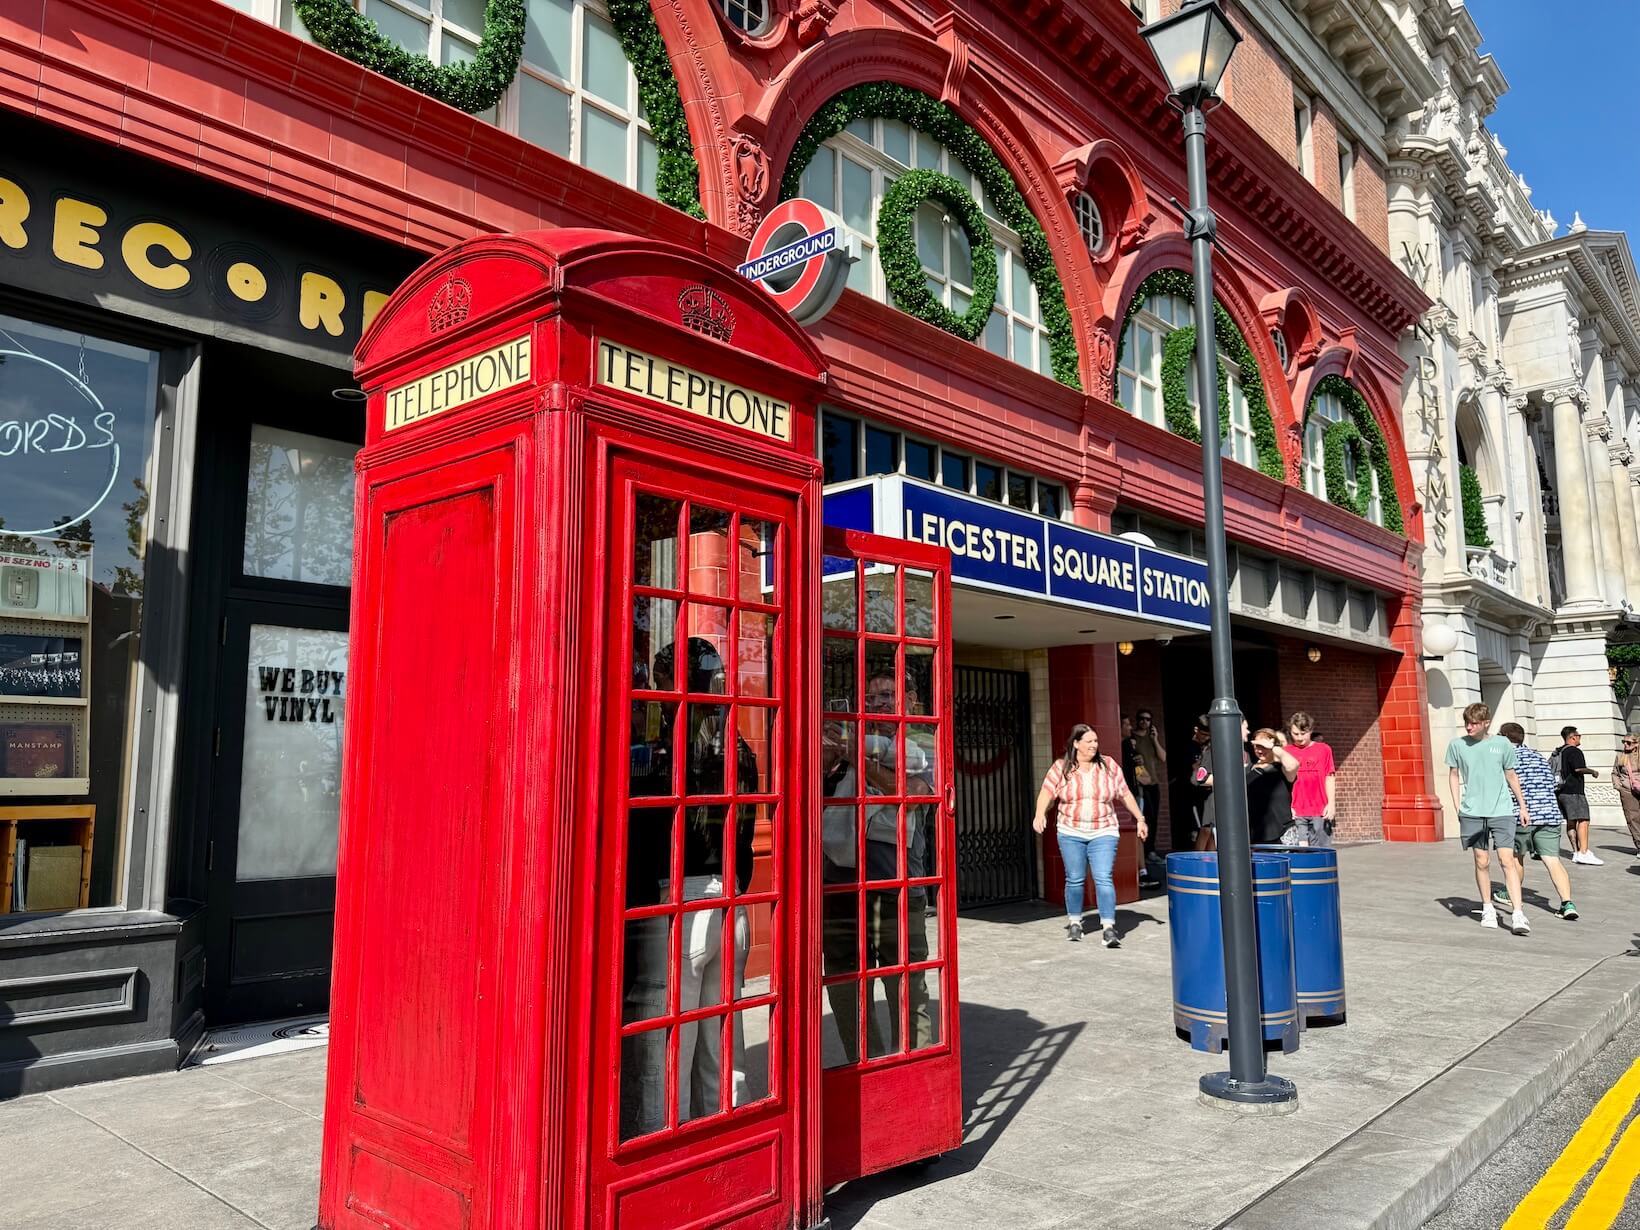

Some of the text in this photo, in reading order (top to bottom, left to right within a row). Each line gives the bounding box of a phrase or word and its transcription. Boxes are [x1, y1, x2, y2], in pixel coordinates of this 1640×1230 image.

[389, 337, 531, 427] TELEPHONE
[600, 341, 790, 440] TELEPHONE
[1401, 240, 1452, 537] WNDHAMS
[906, 508, 1211, 608] LEICESTER SQUARE STATION
[258, 666, 345, 695] WE BUY
[265, 696, 334, 723] VINYL
[9, 742, 62, 750] MANSTAMP
